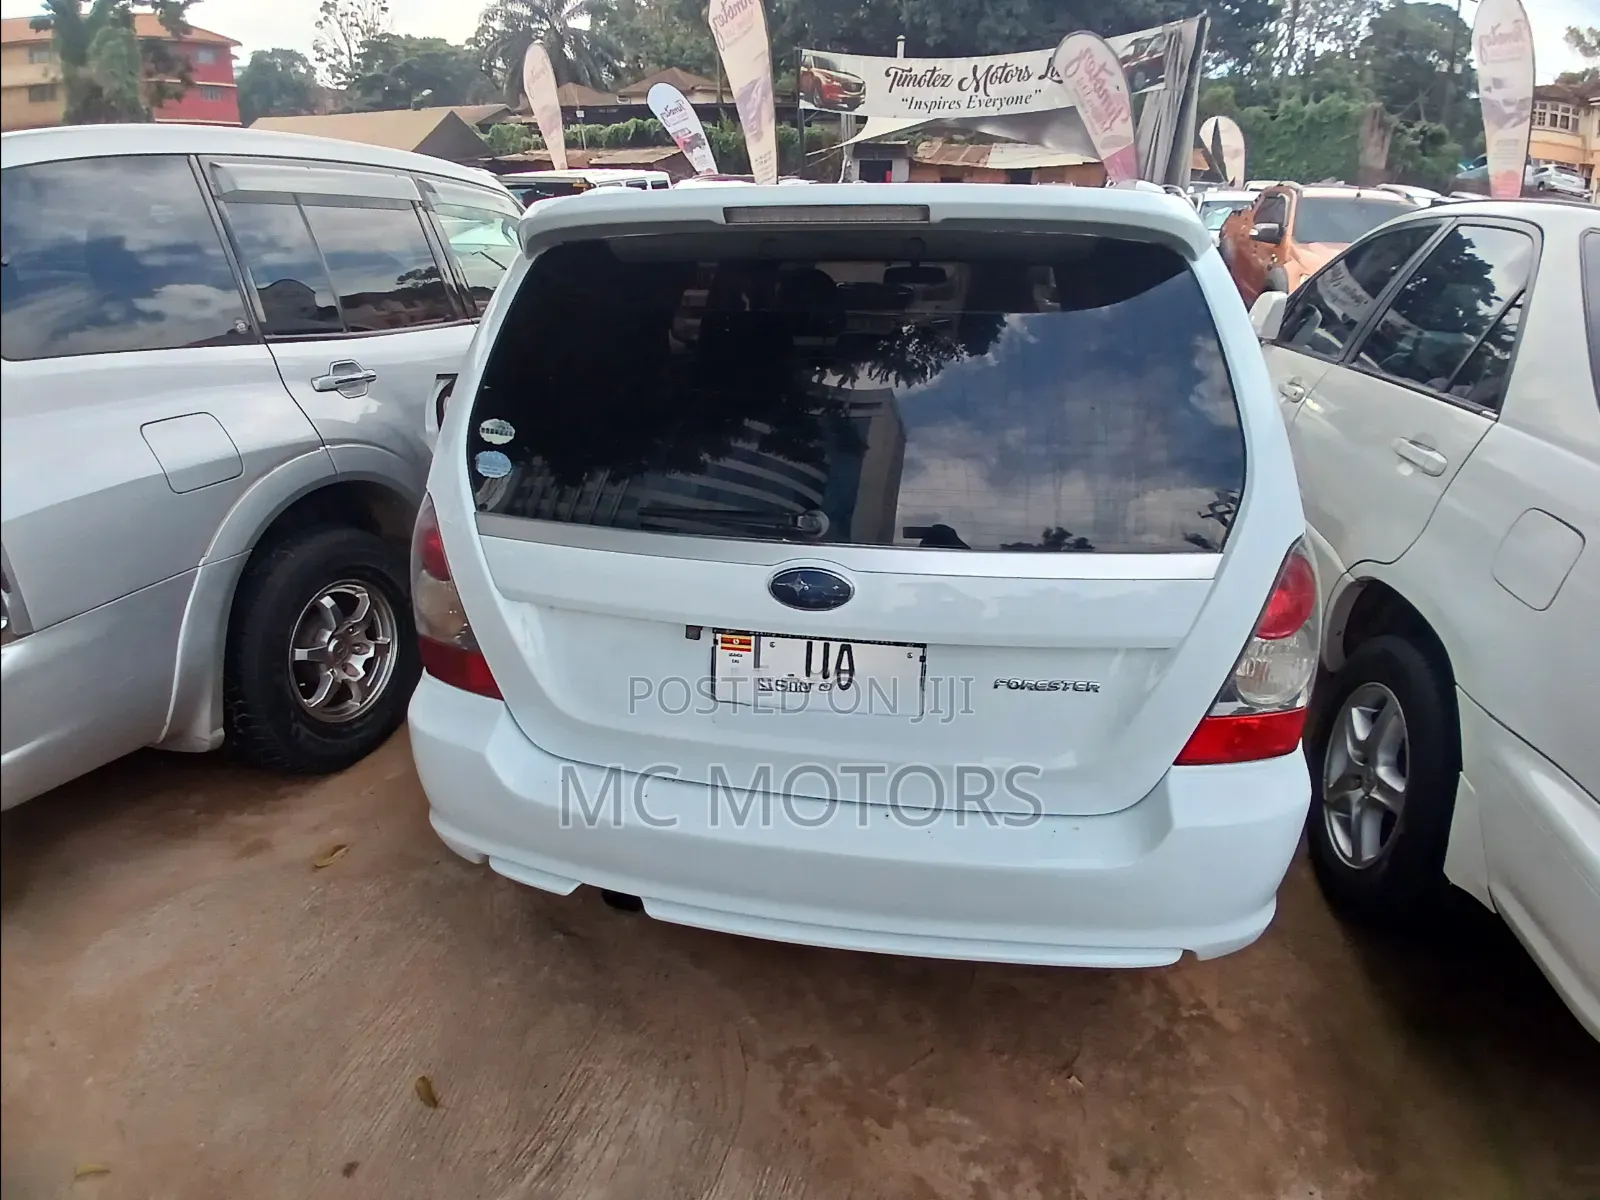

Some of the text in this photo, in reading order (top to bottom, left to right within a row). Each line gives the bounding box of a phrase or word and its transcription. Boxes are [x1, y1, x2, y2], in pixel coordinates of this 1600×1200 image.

[884, 65, 953, 93] Timotez
[957, 61, 1034, 97] Motors
[993, 678, 1101, 693] FORESTER
